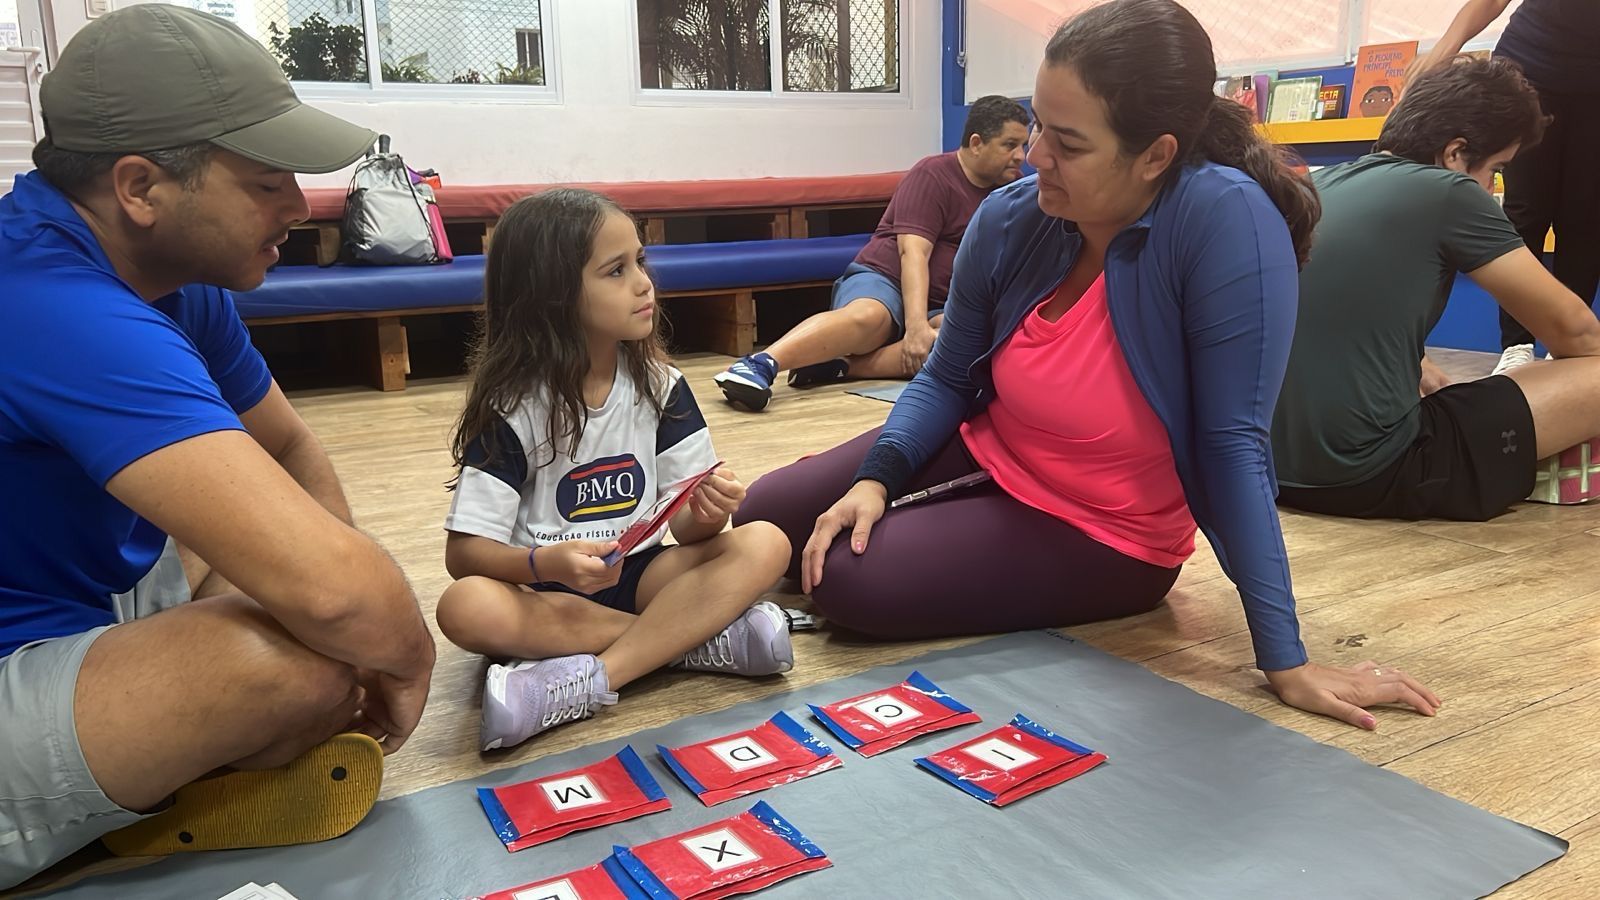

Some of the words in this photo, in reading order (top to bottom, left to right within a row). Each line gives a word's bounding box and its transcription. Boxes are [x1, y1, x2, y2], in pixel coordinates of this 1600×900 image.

[874, 704, 903, 718] C
[730, 747, 761, 762] D
[554, 784, 592, 804] M
[701, 840, 741, 863] X
